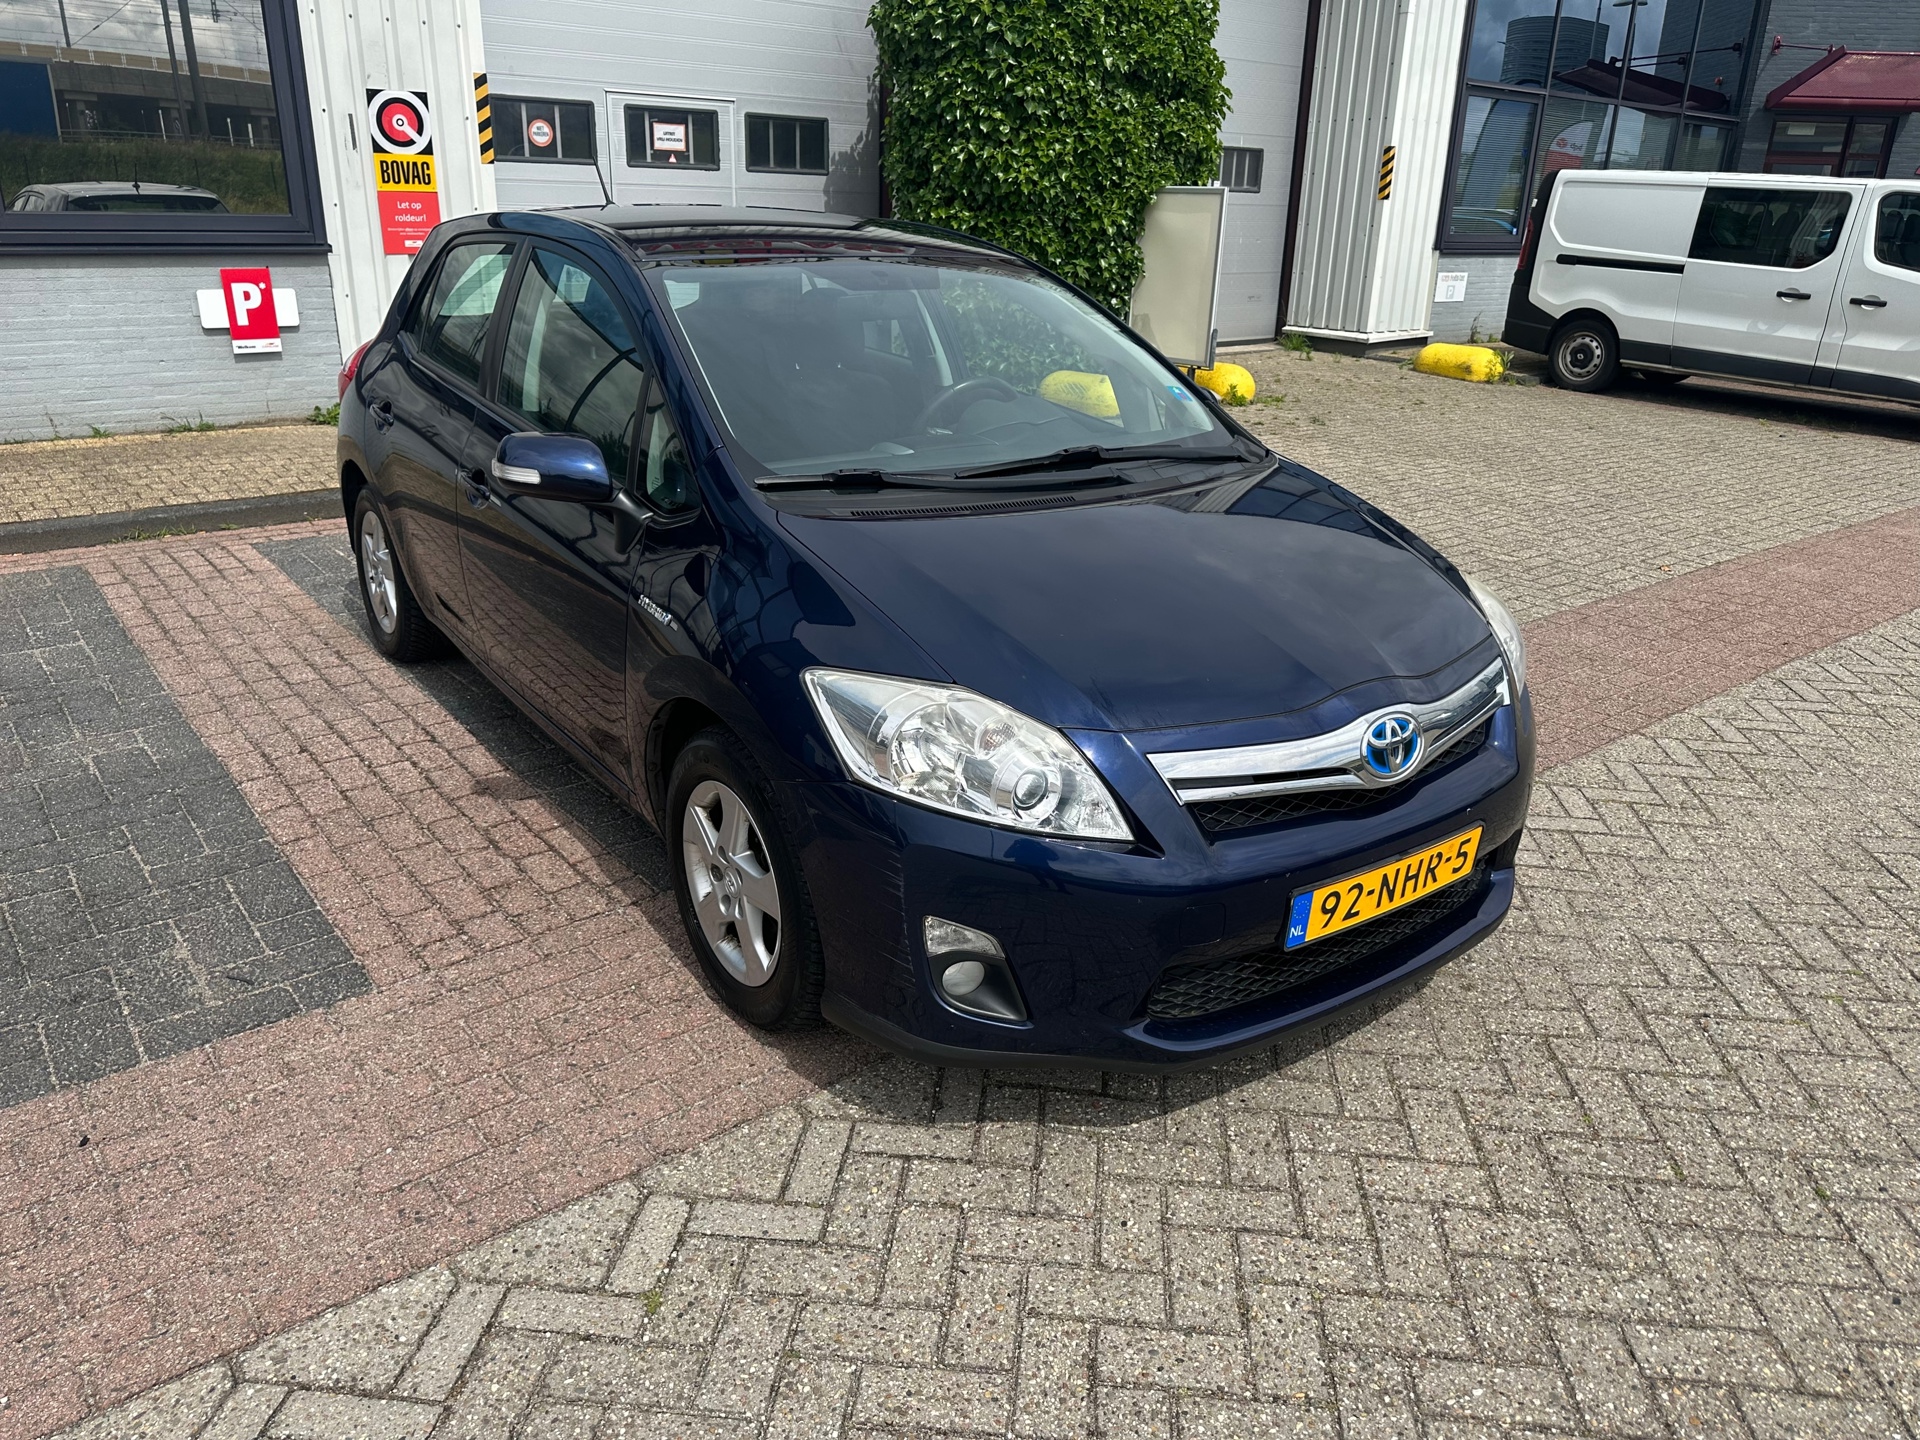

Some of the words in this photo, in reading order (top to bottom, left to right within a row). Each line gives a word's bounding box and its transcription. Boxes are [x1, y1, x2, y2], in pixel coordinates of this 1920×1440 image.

[379, 160, 432, 186] BOVAG
[397, 201, 410, 209] Let
[411, 202, 422, 211] op
[394, 213, 427, 222] roldeur!
[1320, 836, 1472, 930] 92-NHR-5
[1289, 924, 1304, 938] NL
